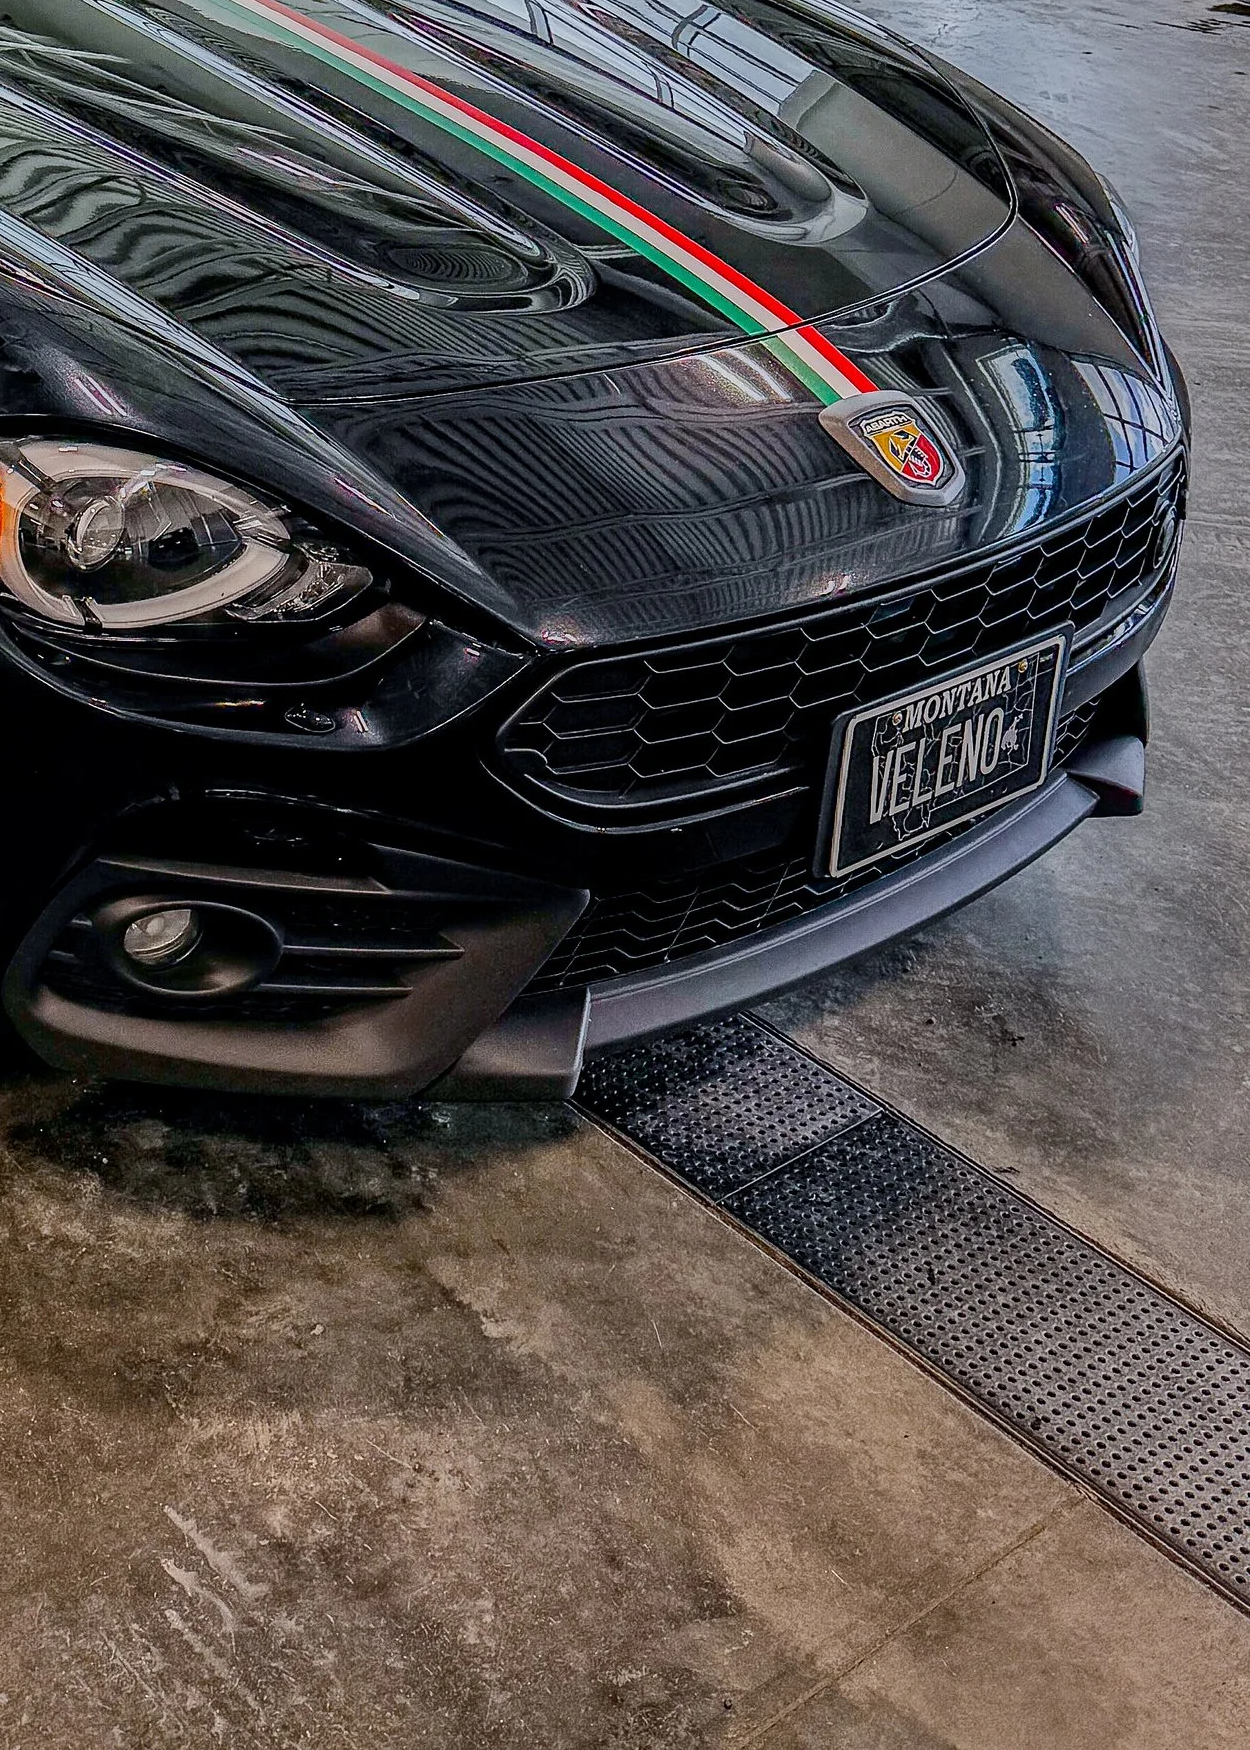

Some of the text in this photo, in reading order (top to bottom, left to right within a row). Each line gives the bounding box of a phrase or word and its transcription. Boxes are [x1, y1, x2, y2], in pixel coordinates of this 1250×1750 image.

[865, 415, 908, 433] ABARTH
[902, 666, 1012, 734] MONTANA
[869, 706, 1005, 825] VELENO
